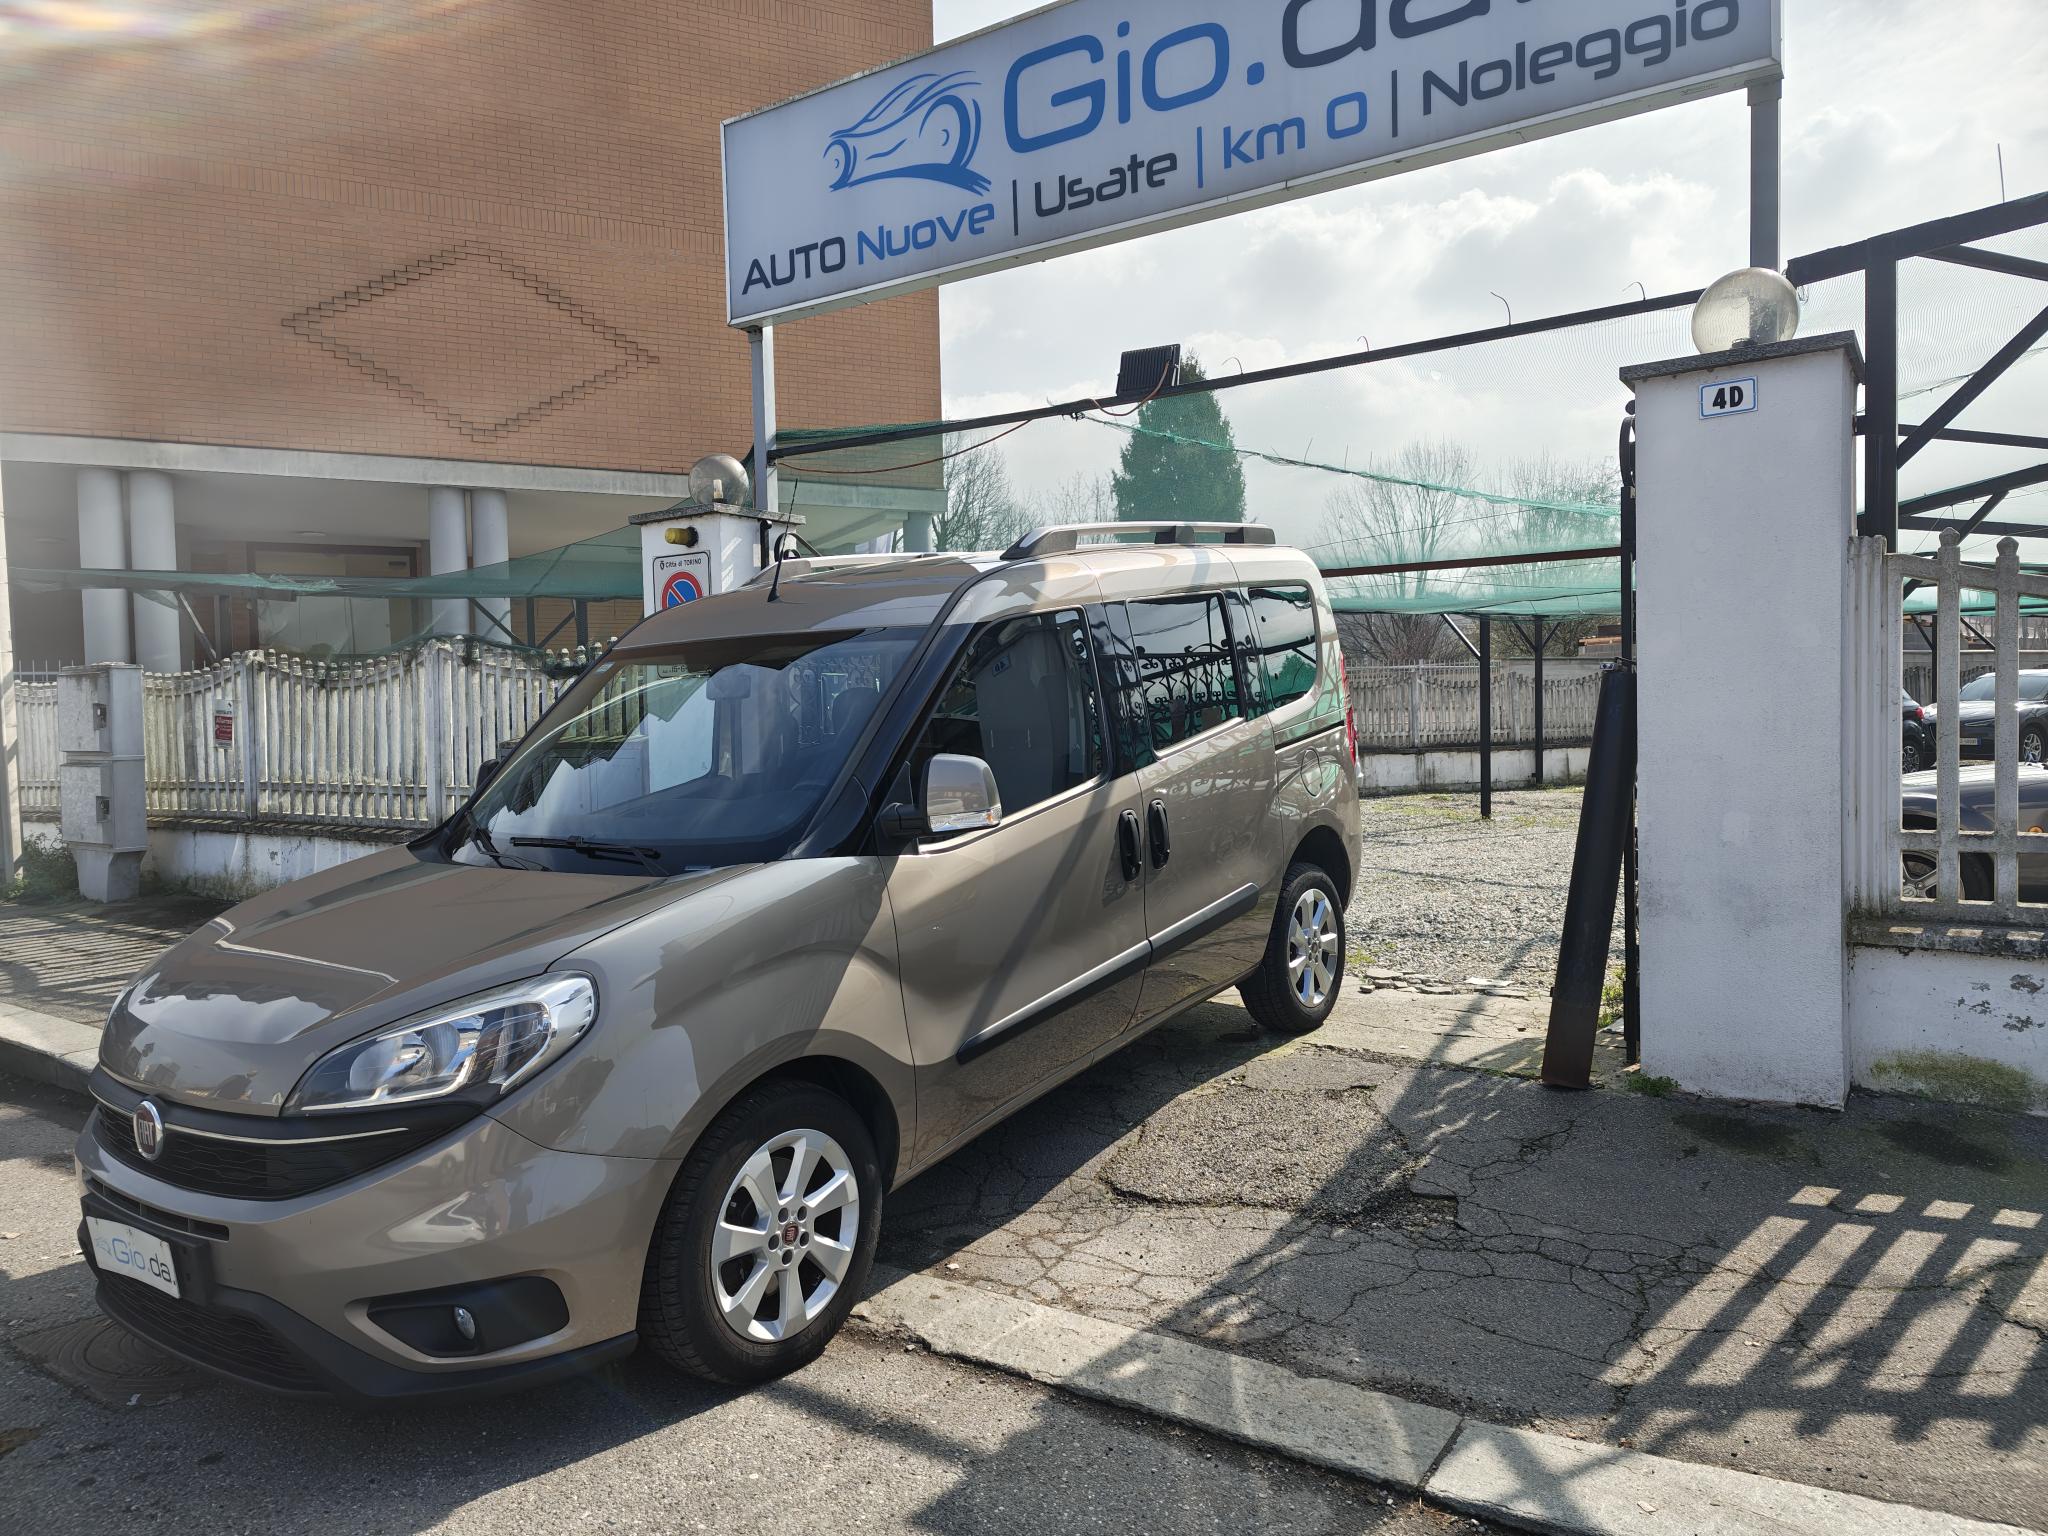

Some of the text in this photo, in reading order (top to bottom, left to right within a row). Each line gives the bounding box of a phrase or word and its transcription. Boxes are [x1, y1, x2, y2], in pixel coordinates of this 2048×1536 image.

[742, 236, 846, 295] AUTO
[857, 203, 995, 265] Nuove
[1034, 152, 1178, 217] Usate
[1223, 116, 1306, 169] km
[1422, 0, 1740, 116] Noleggio
[1712, 385, 1744, 409] 4D
[138, 1119, 154, 1146] FIAT
